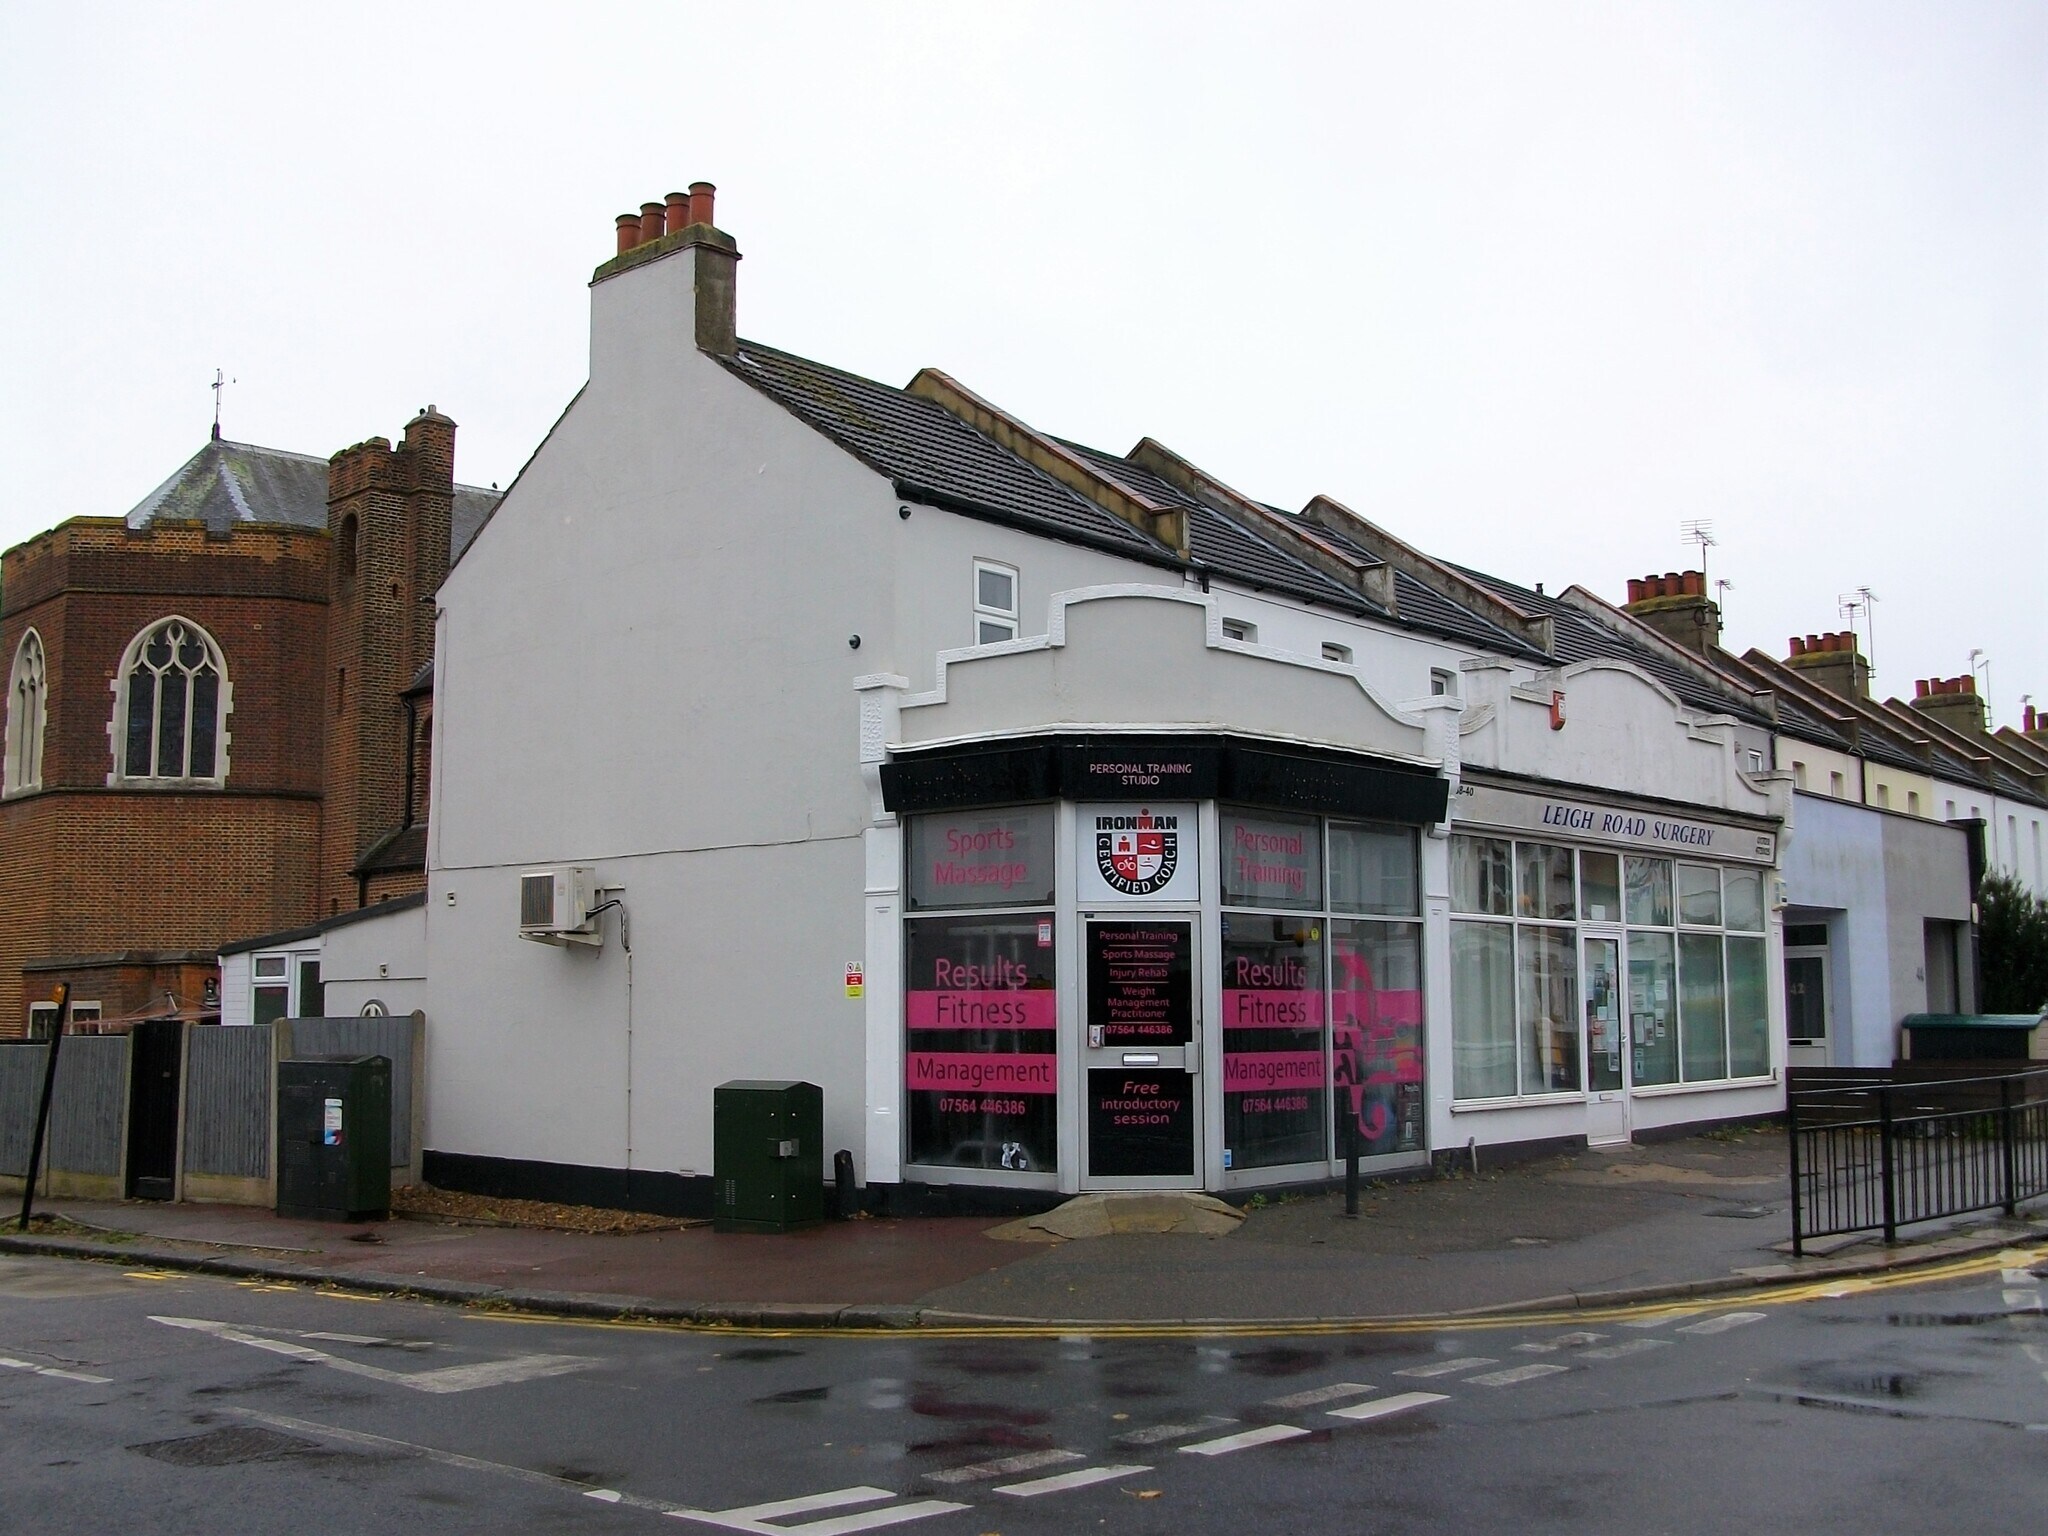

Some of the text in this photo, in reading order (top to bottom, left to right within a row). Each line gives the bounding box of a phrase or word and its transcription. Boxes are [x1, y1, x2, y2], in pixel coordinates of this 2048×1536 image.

[1089, 763, 1192, 774] PERSONAL TRAINING
[1121, 775, 1160, 785] STUDIO
[1096, 815, 1178, 830] IRONMAN
[1542, 804, 1715, 846] LEIGH ROAD SURGERY
[946, 827, 1015, 859] Sports
[1233, 825, 1303, 856] Personal
[1098, 837, 1176, 893] CERTIFIED COACH
[934, 861, 1027, 890] Massage
[1237, 855, 1305, 892] Training
[1099, 931, 1178, 942] Personal Training
[1102, 949, 1176, 961] Sports Massage
[935, 955, 1029, 988] Results
[1109, 968, 1168, 979] Injury Rehab
[1236, 955, 1307, 987] Results
[1122, 987, 1156, 998] Weight
[937, 995, 1026, 1024] Fitness
[1107, 998, 1170, 1009] Management
[1238, 994, 1307, 1024] Fitness
[1111, 1009, 1167, 1018] Practitioner
[1105, 1025, 1173, 1034] 07564 446386
[916, 1057, 1050, 1087] Management
[1225, 1059, 1321, 1086] Management
[1122, 1081, 1160, 1094] Free
[940, 1098, 1025, 1115] 07564 446386
[1101, 1097, 1180, 1112] introductory
[1242, 1098, 1272, 1113] 07564
[1113, 1112, 1170, 1125] session
